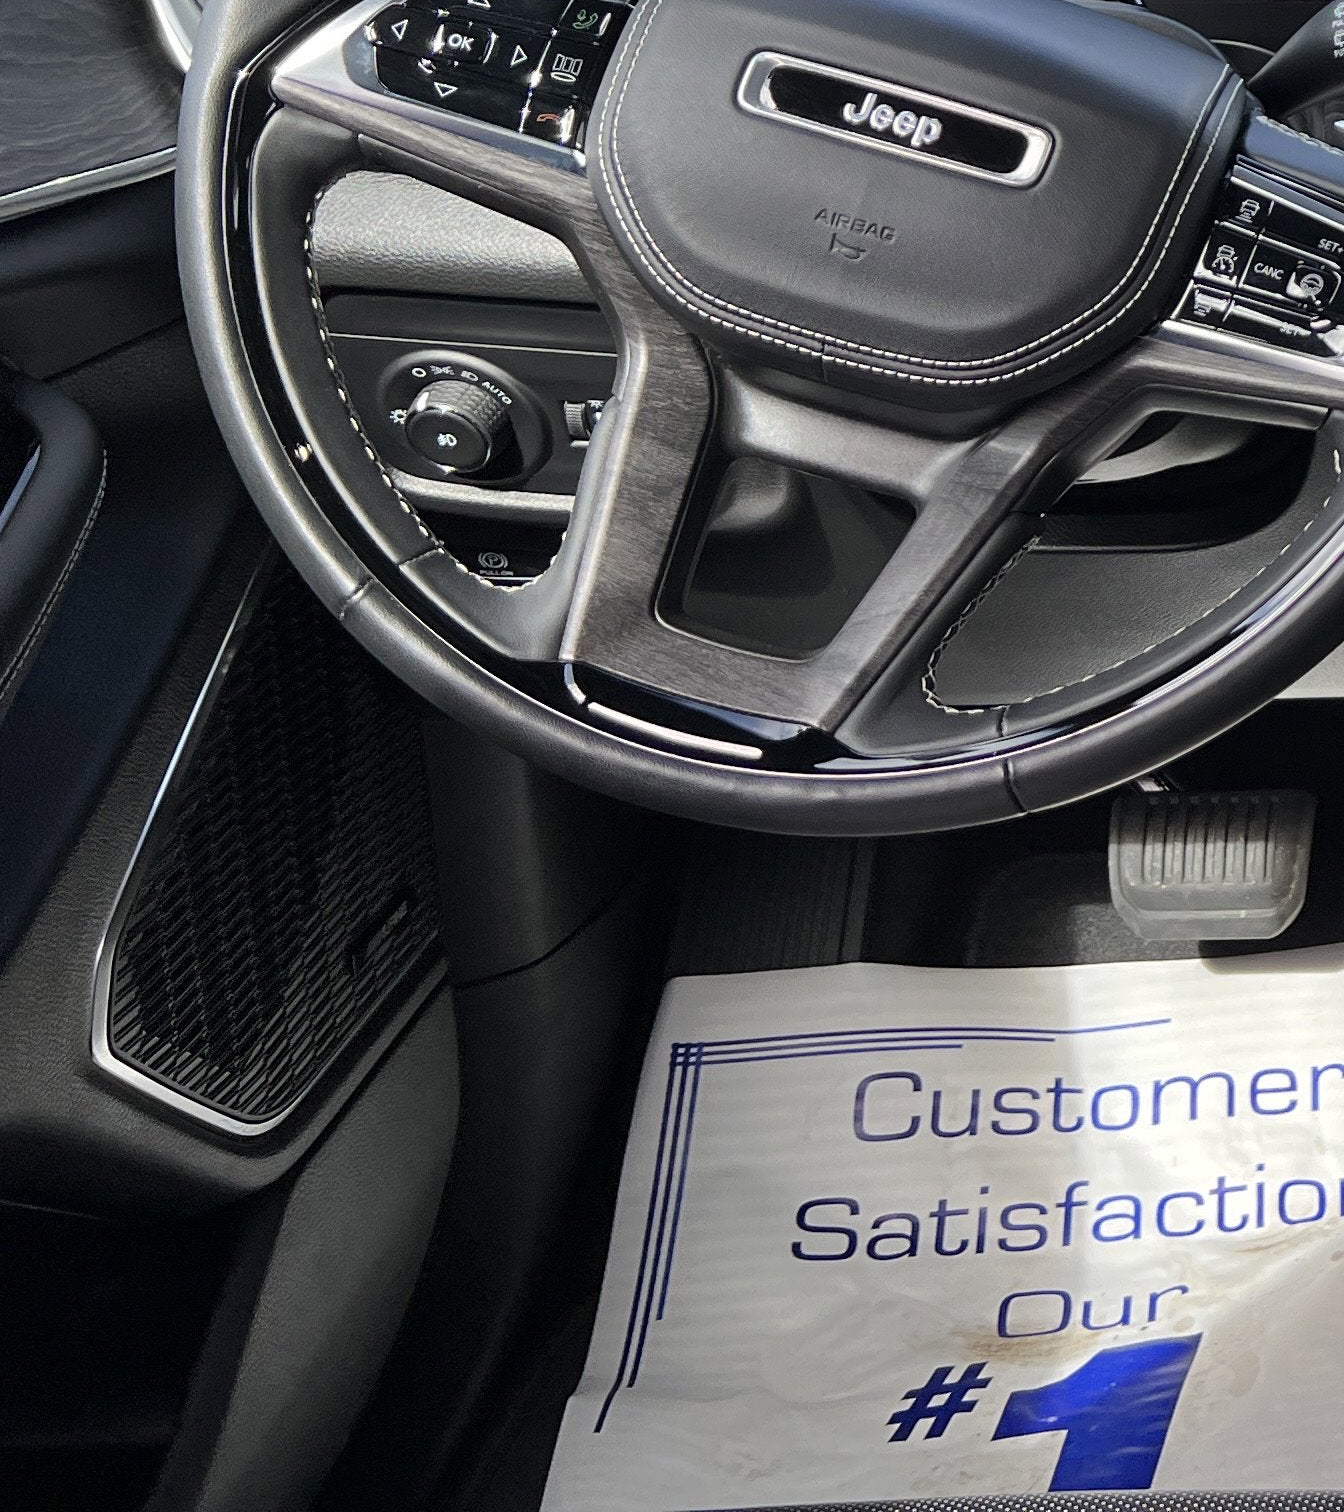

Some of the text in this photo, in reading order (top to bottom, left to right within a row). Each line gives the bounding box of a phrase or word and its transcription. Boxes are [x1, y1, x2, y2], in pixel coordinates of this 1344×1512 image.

[448, 33, 475, 51] OK
[841, 91, 943, 148] Jeep
[813, 207, 896, 242] AIRBAG
[1253, 262, 1285, 281] CANC
[481, 381, 513, 406] AUTO
[995, 1284, 1191, 1341] Our
[885, 1330, 1205, 1494] #1
